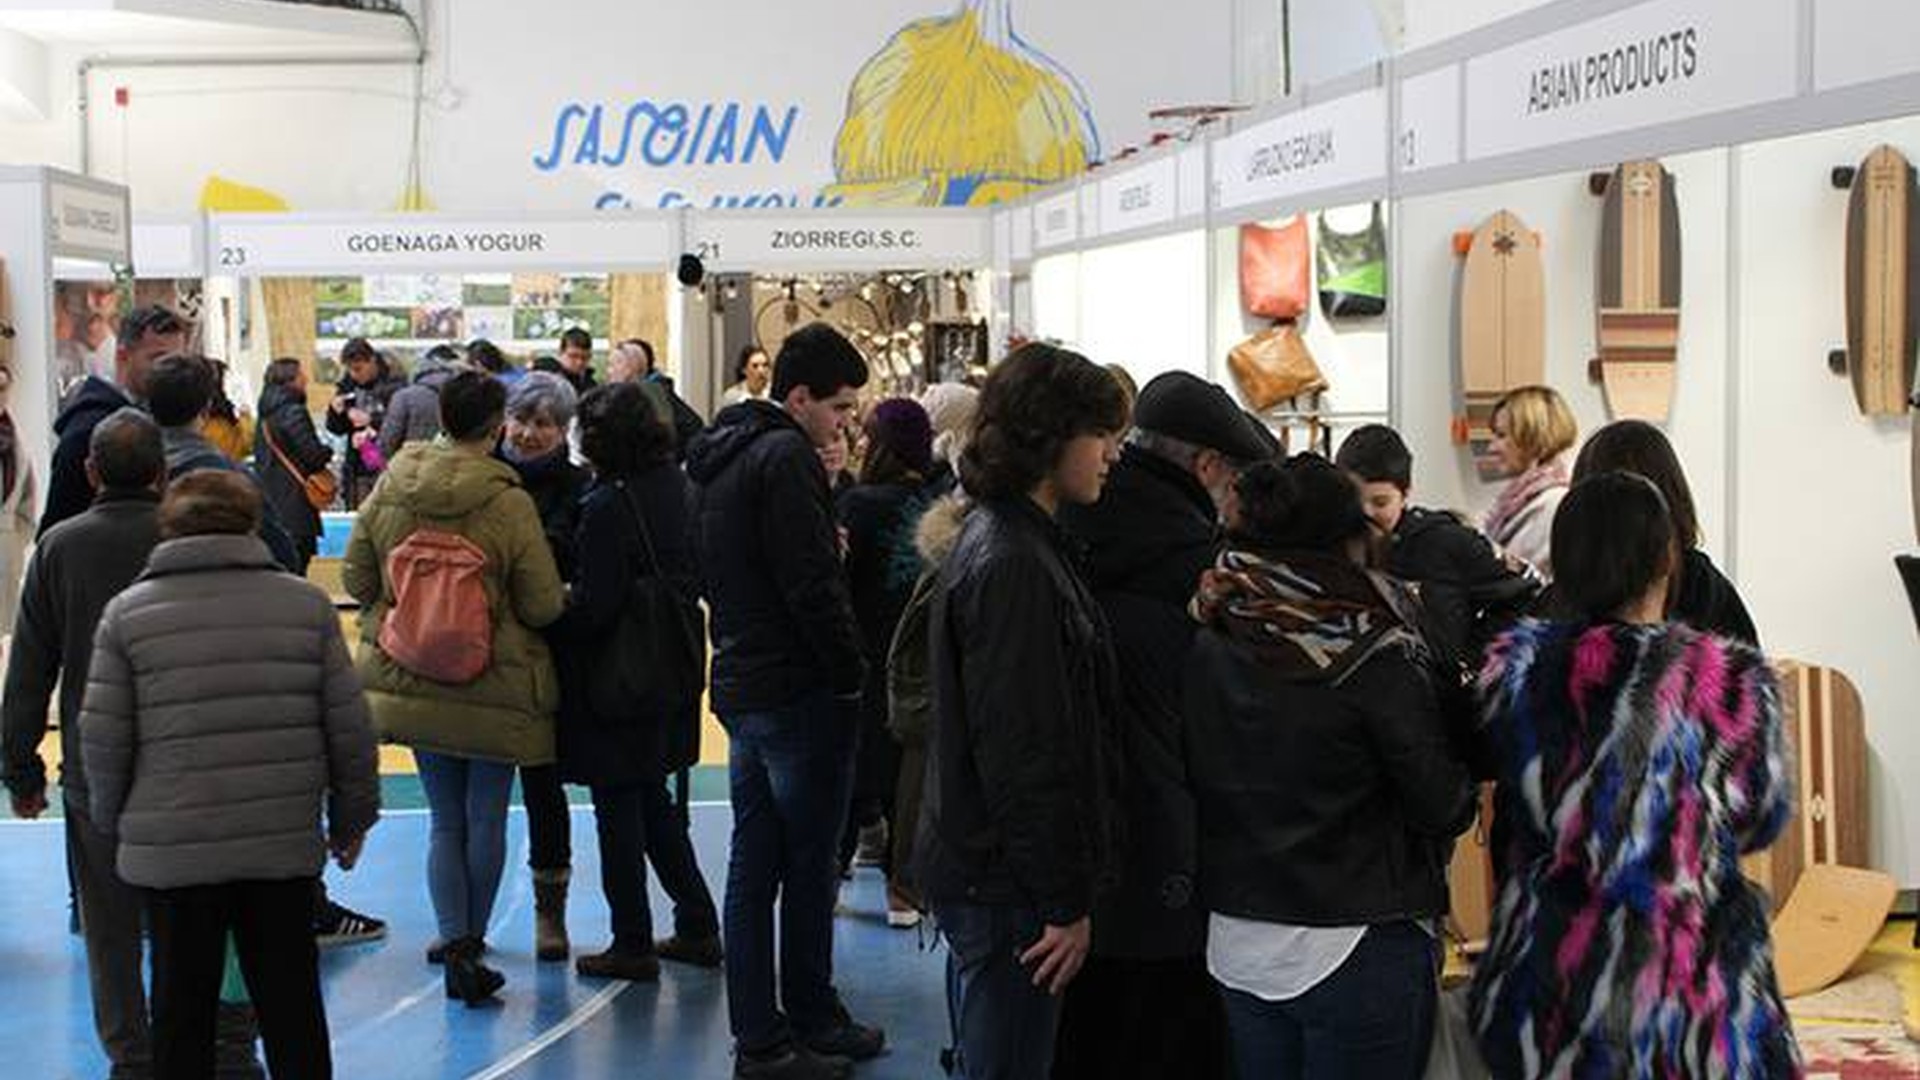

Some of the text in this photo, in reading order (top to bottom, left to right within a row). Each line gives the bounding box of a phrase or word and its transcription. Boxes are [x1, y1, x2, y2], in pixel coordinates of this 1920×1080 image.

[1526, 27, 1697, 114] ABIAN PRODUCTS
[533, 101, 798, 170] SASOIAN
[347, 233, 544, 253] GOENAGA YOGUR
[698, 241, 720, 260] 21
[220, 246, 246, 266] 23
